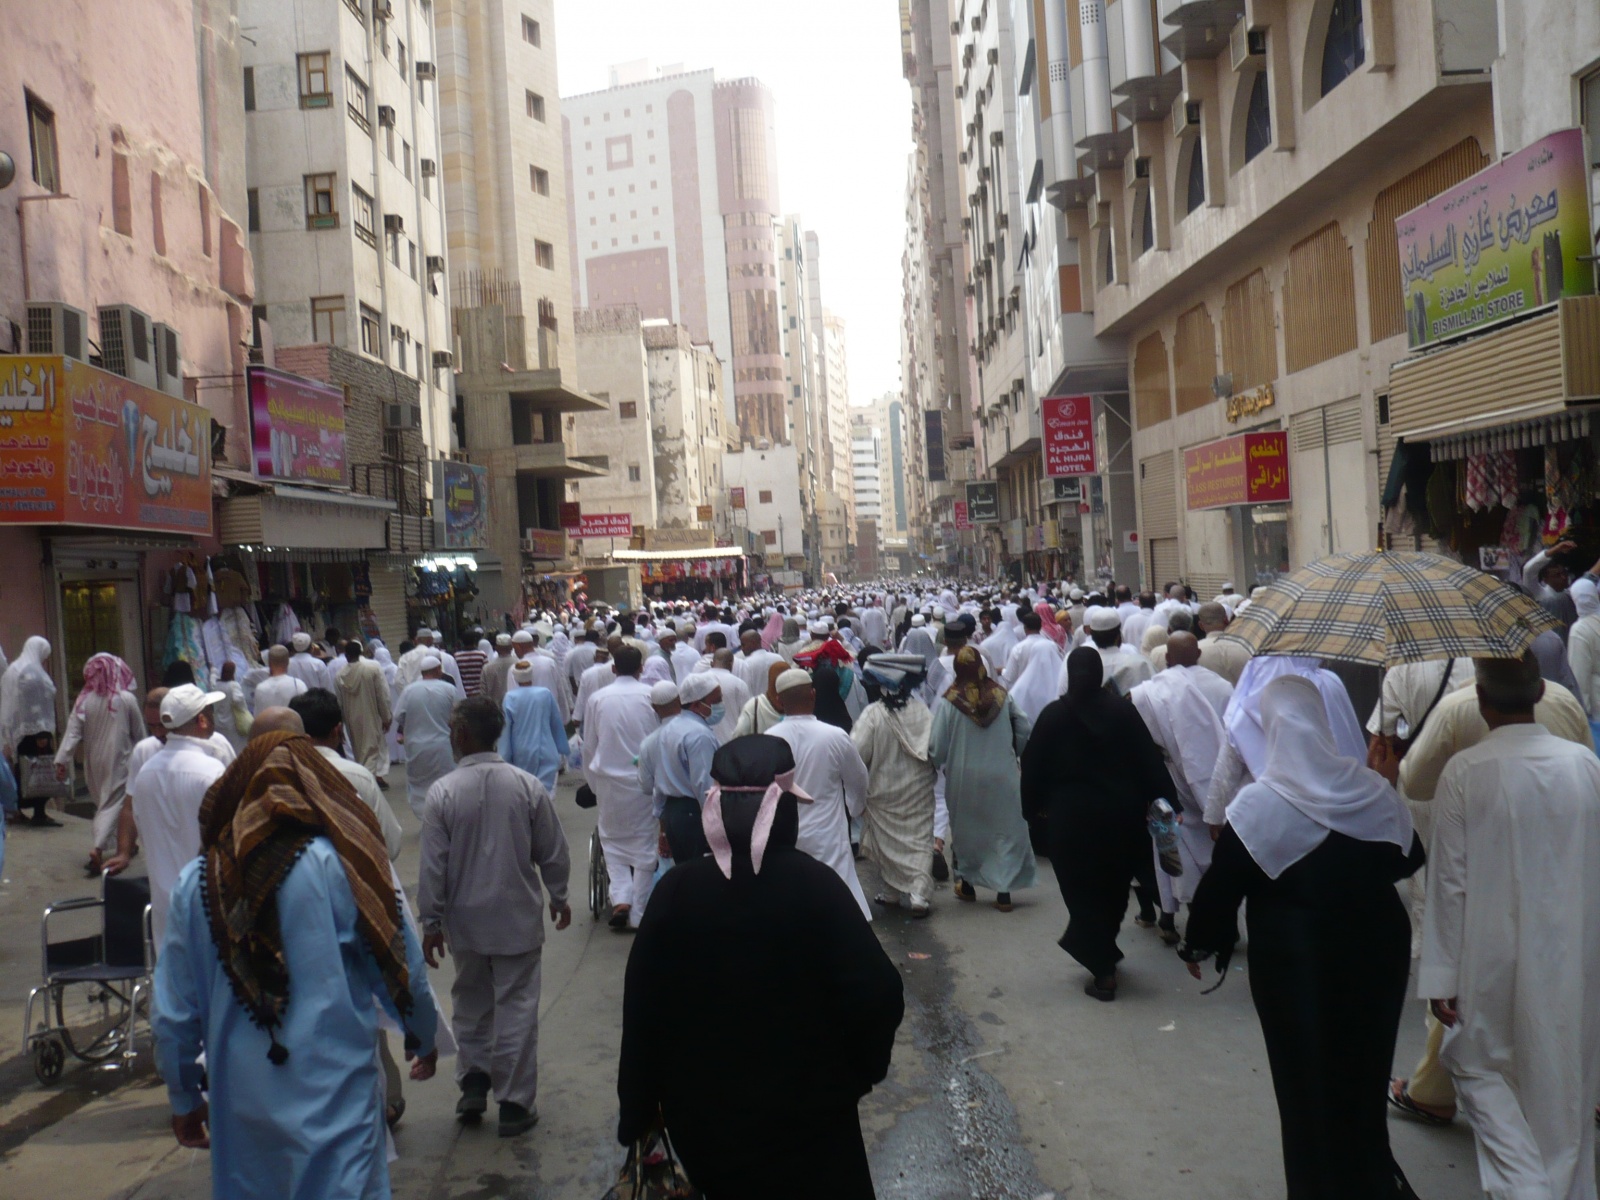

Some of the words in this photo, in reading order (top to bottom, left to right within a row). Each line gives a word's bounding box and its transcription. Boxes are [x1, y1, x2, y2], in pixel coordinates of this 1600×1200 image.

[1498, 188, 1558, 250] معرض
[1432, 306, 1485, 336] BISMILLAH
[1487, 291, 1524, 318] STORE
[0, 362, 56, 428] الخلي
[1054, 428, 1084, 441] فندق
[142, 407, 208, 497] الخليج
[1049, 441, 1091, 455] الهجرة
[1050, 456, 1061, 464] AL
[1249, 438, 1284, 464] المطعم
[1055, 464, 1086, 473] HOTEL
[1250, 464, 1287, 494] الراقي
[583, 526, 607, 535] PALACE
[608, 525, 630, 534] HOTEL
